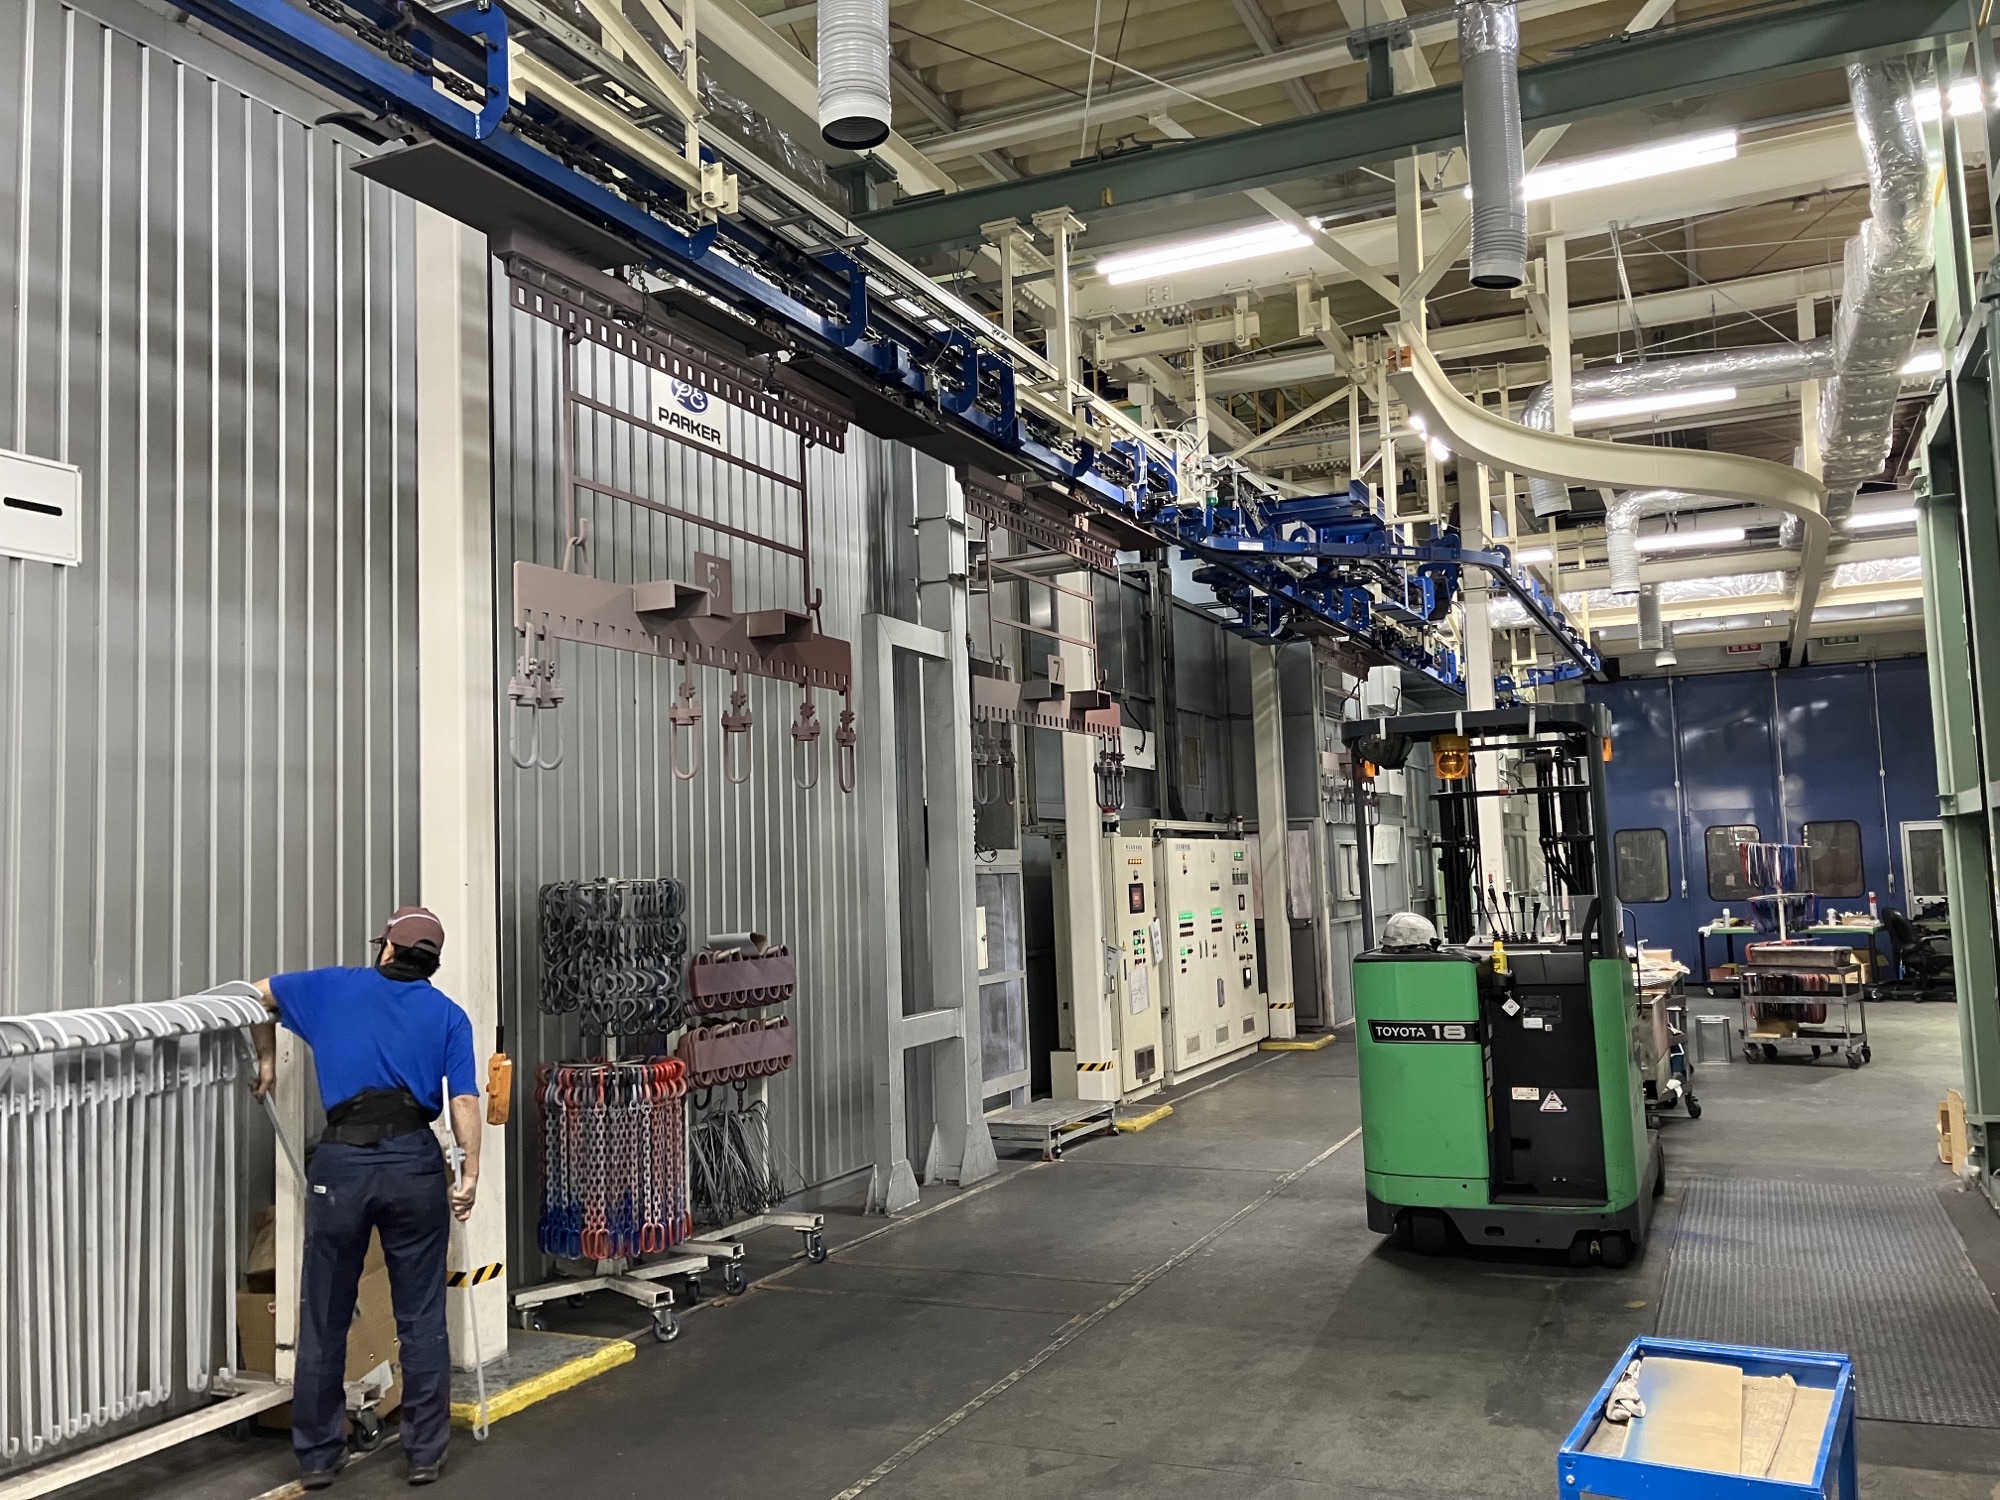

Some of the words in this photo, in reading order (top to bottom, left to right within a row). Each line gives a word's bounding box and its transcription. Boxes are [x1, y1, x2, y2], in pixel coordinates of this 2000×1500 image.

[658, 406, 722, 445] PARKER
[706, 561, 721, 599] 5
[1053, 660, 1061, 682] 7
[1375, 1025, 1427, 1039] TOYOTA
[1431, 1024, 1467, 1040] 18
